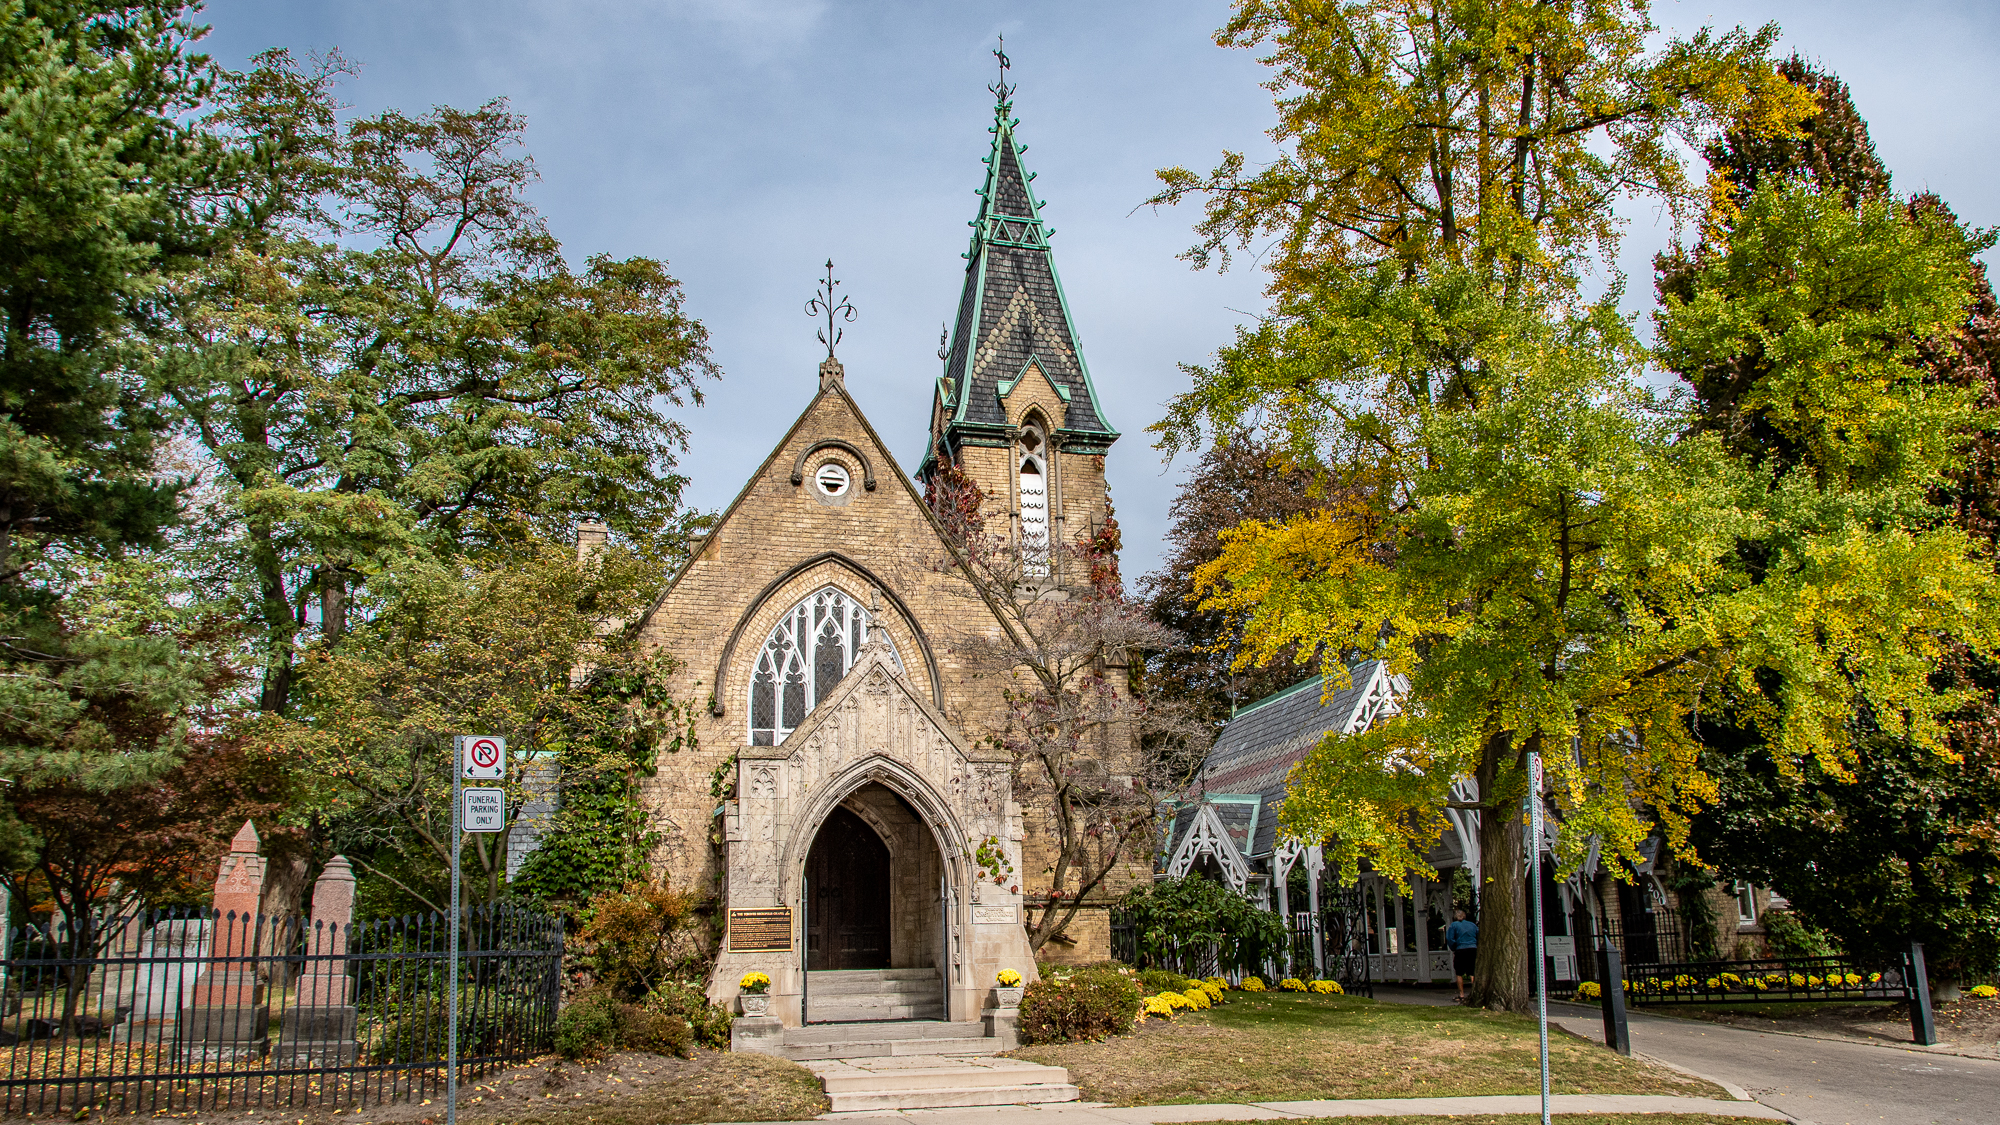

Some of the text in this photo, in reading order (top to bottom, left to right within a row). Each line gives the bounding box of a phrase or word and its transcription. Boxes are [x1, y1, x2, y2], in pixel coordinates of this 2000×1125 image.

[468, 795, 498, 804] FUNERAL
[476, 816, 493, 824] ONLY
[1647, 882, 1666, 906] 200
